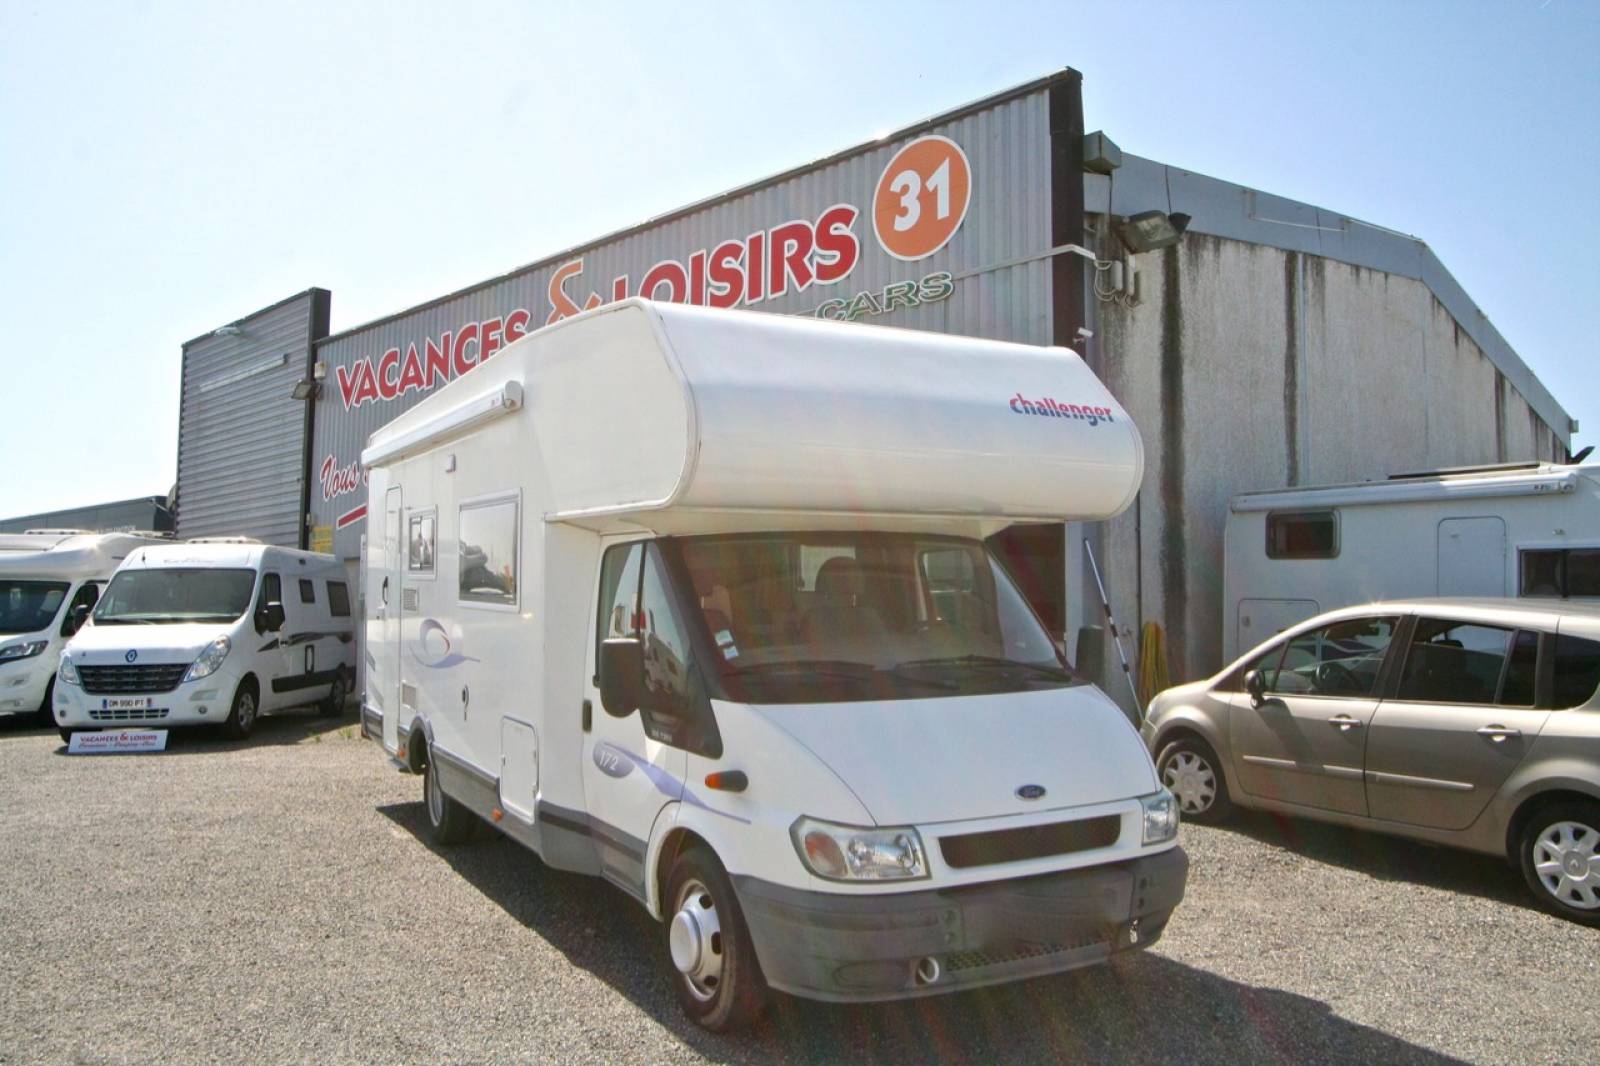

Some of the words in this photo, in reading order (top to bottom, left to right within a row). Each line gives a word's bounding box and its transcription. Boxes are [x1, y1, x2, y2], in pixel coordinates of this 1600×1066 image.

[890, 157, 950, 232] 31
[815, 271, 954, 321] CARS
[336, 308, 531, 413] VACANCES
[1009, 392, 1114, 427] challenger
[320, 454, 360, 502] Vous
[599, 751, 620, 771] 172
